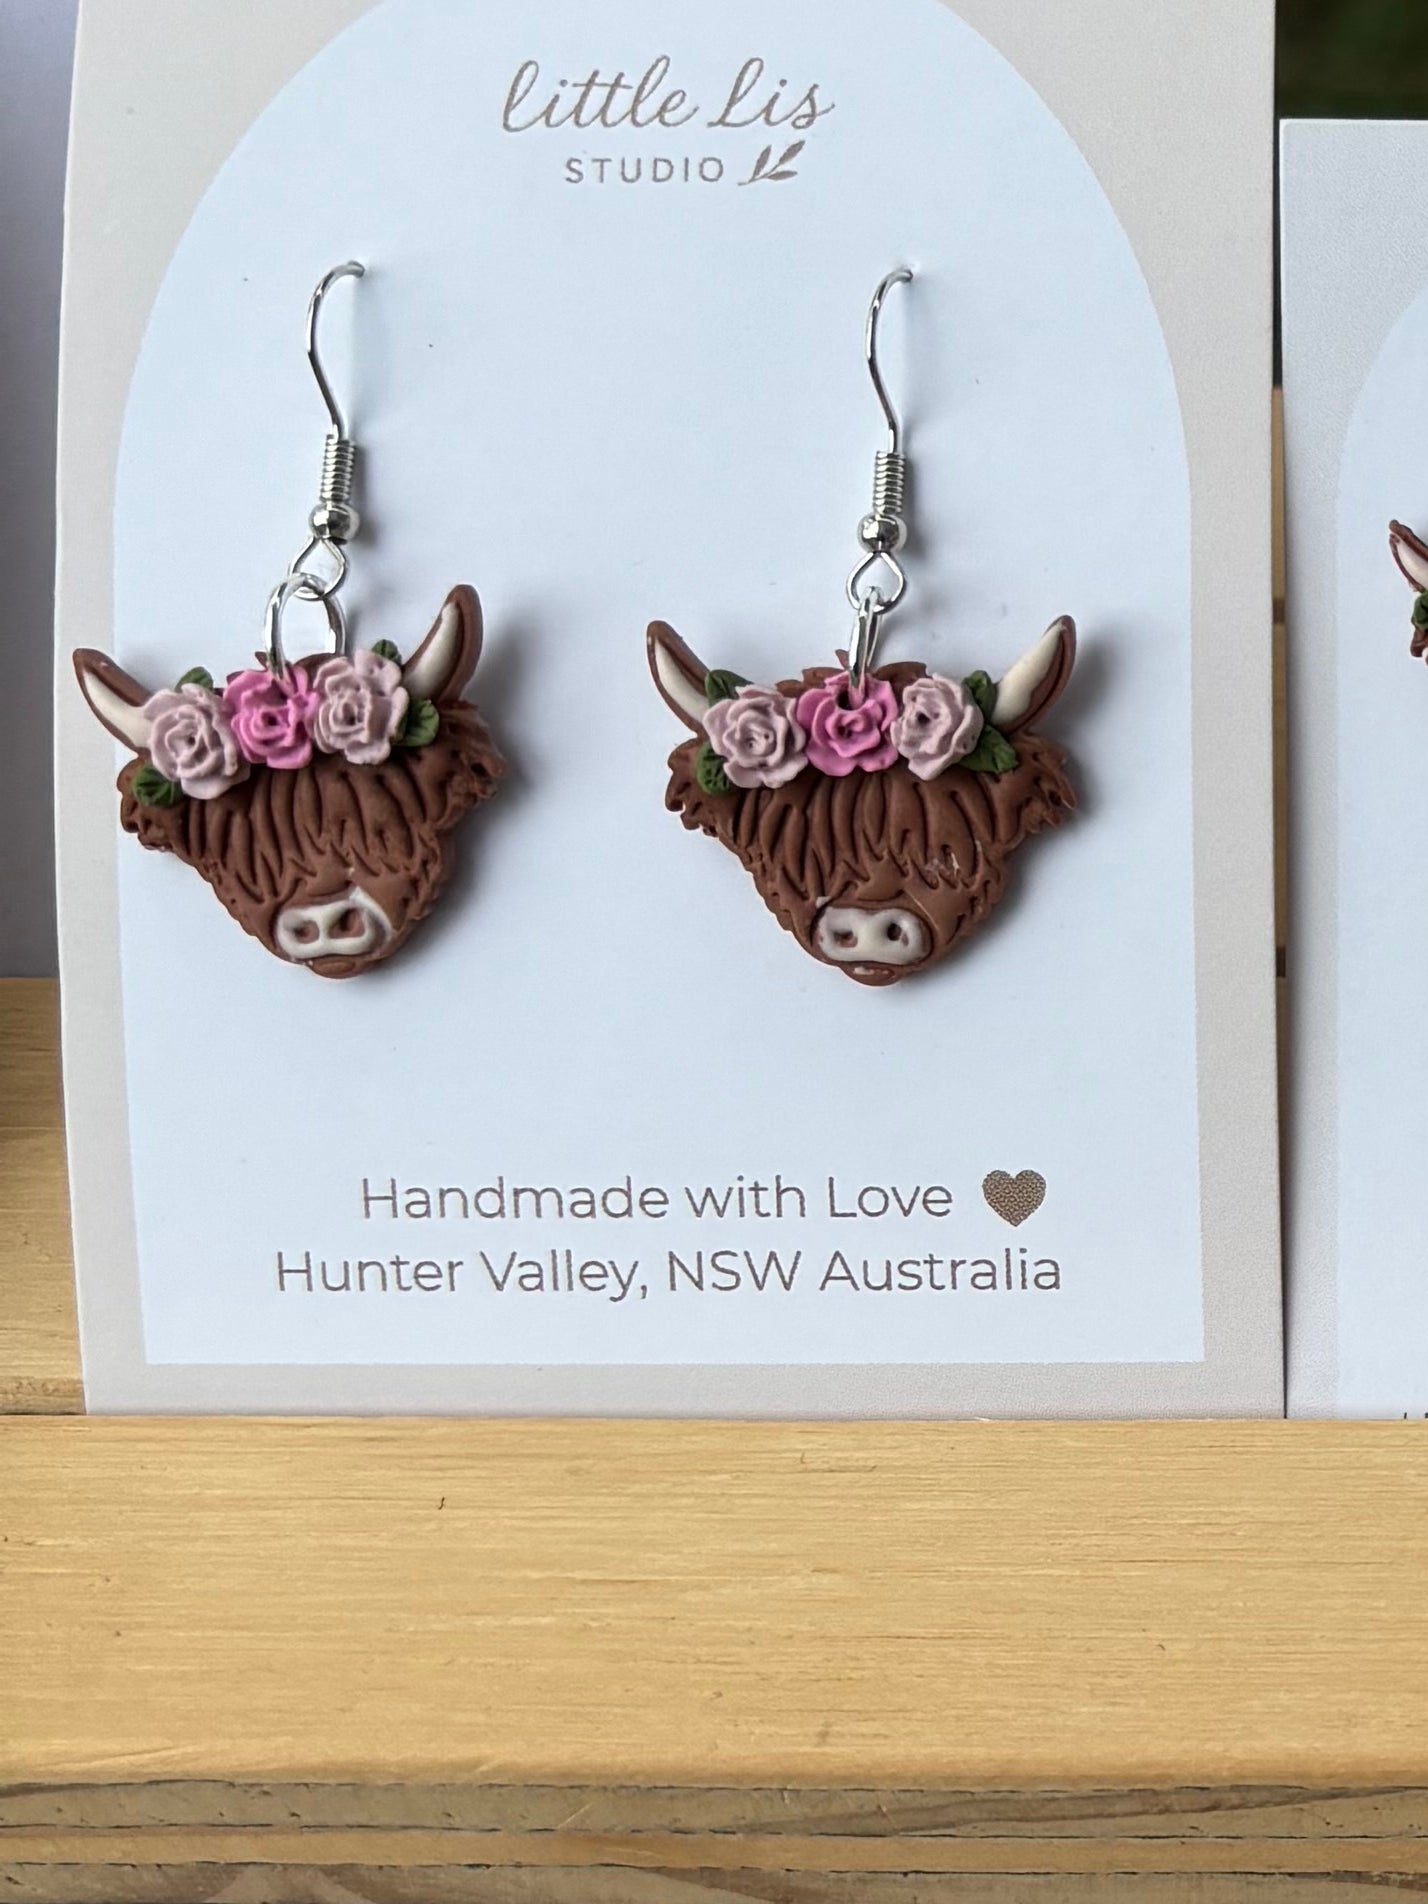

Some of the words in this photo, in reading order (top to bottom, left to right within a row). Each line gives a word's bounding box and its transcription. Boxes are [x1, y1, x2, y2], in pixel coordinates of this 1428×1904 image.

[502, 54, 700, 133] little
[706, 56, 836, 130] Lis
[565, 156, 724, 184] STUDIO
[362, 1175, 670, 1219] Handmade
[684, 1174, 806, 1219] with
[828, 1176, 953, 1218] Love
[277, 1250, 464, 1292] Hunter
[479, 1248, 648, 1303] Valley,
[668, 1249, 802, 1292] NSW
[818, 1247, 1061, 1292] Australia
